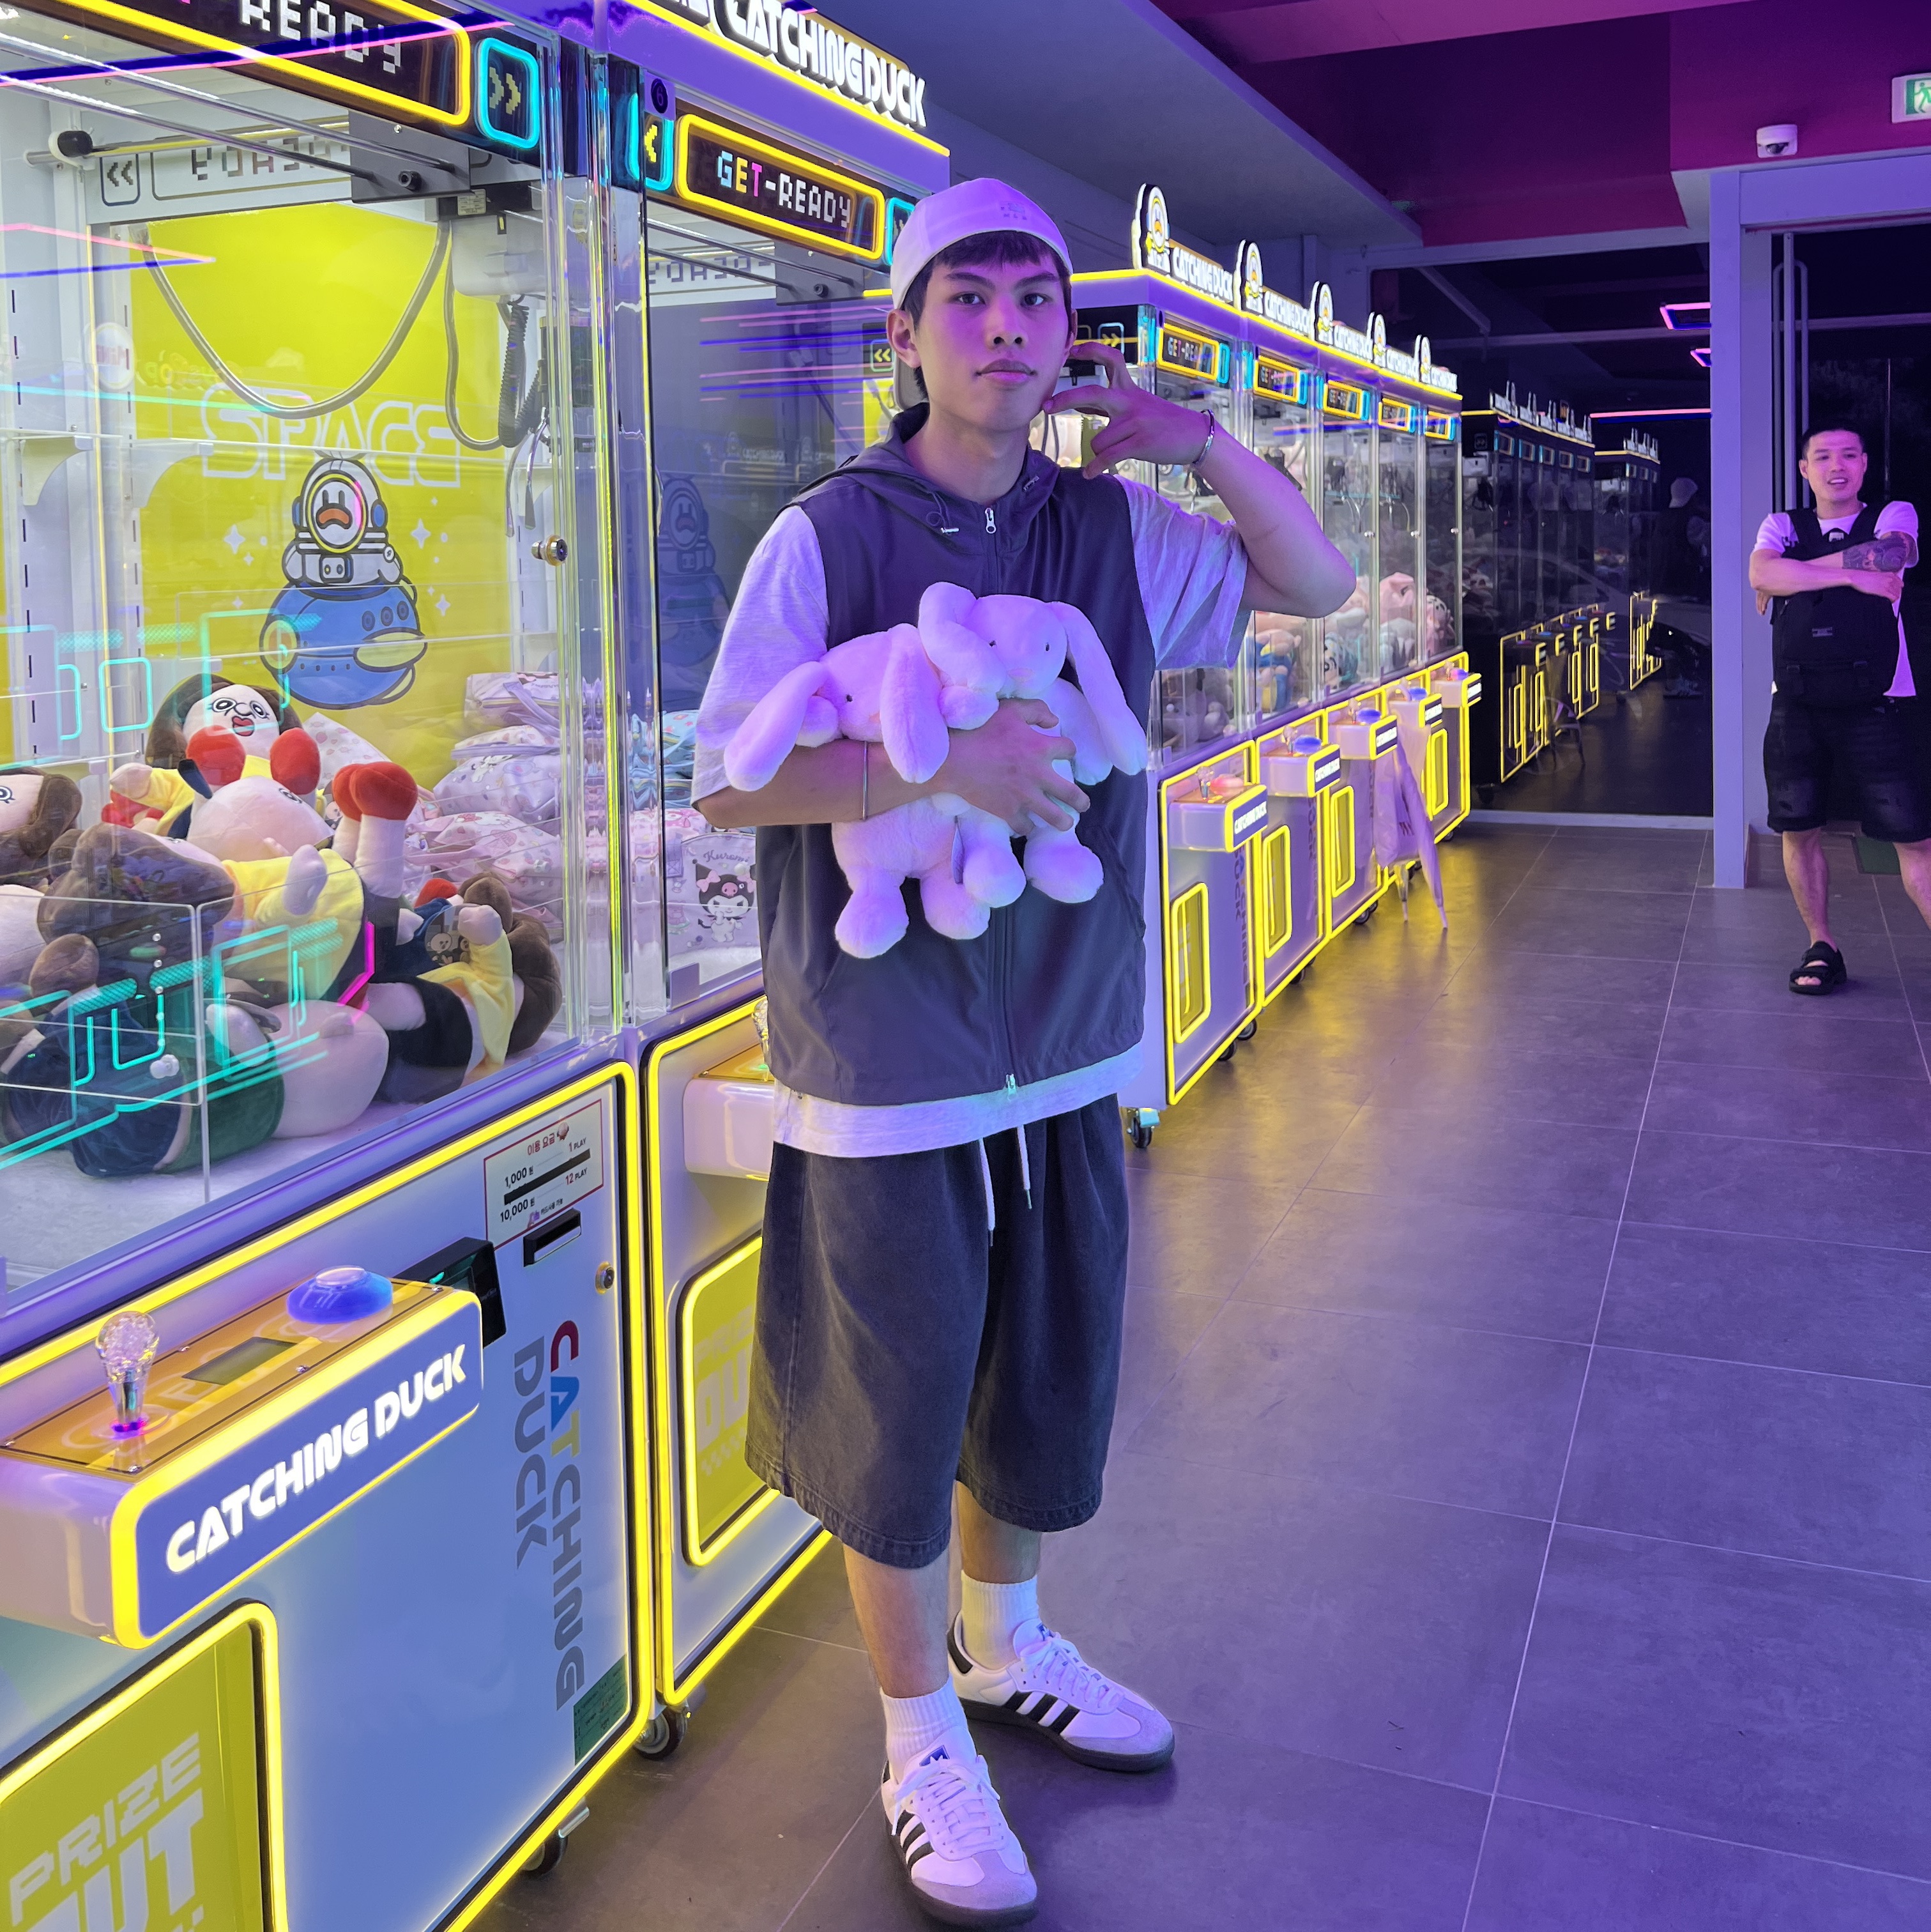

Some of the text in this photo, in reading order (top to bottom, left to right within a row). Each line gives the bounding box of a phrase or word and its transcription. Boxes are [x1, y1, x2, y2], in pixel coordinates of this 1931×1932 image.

[238, 0, 402, 75] READY
[717, 150, 851, 229] GET-READY
[200, 382, 461, 487] SPACE
[703, 849, 751, 862] Kuromi
[505, 1137, 587, 1188] 1,000 원 1 PLAY
[528, 1132, 555, 1156] 이용 요금
[500, 1167, 588, 1223] 10,000 원 12 PLAY
[694, 1304, 754, 1377] PRIZ
[697, 1341, 752, 1453] OU
[167, 1344, 467, 1574] CATCHING DUCK
[514, 1336, 547, 1571] DUCK
[550, 1319, 585, 1712] CATCHING
[10, 1731, 201, 1927] PRIZE
[26, 1788, 204, 1932] UT
